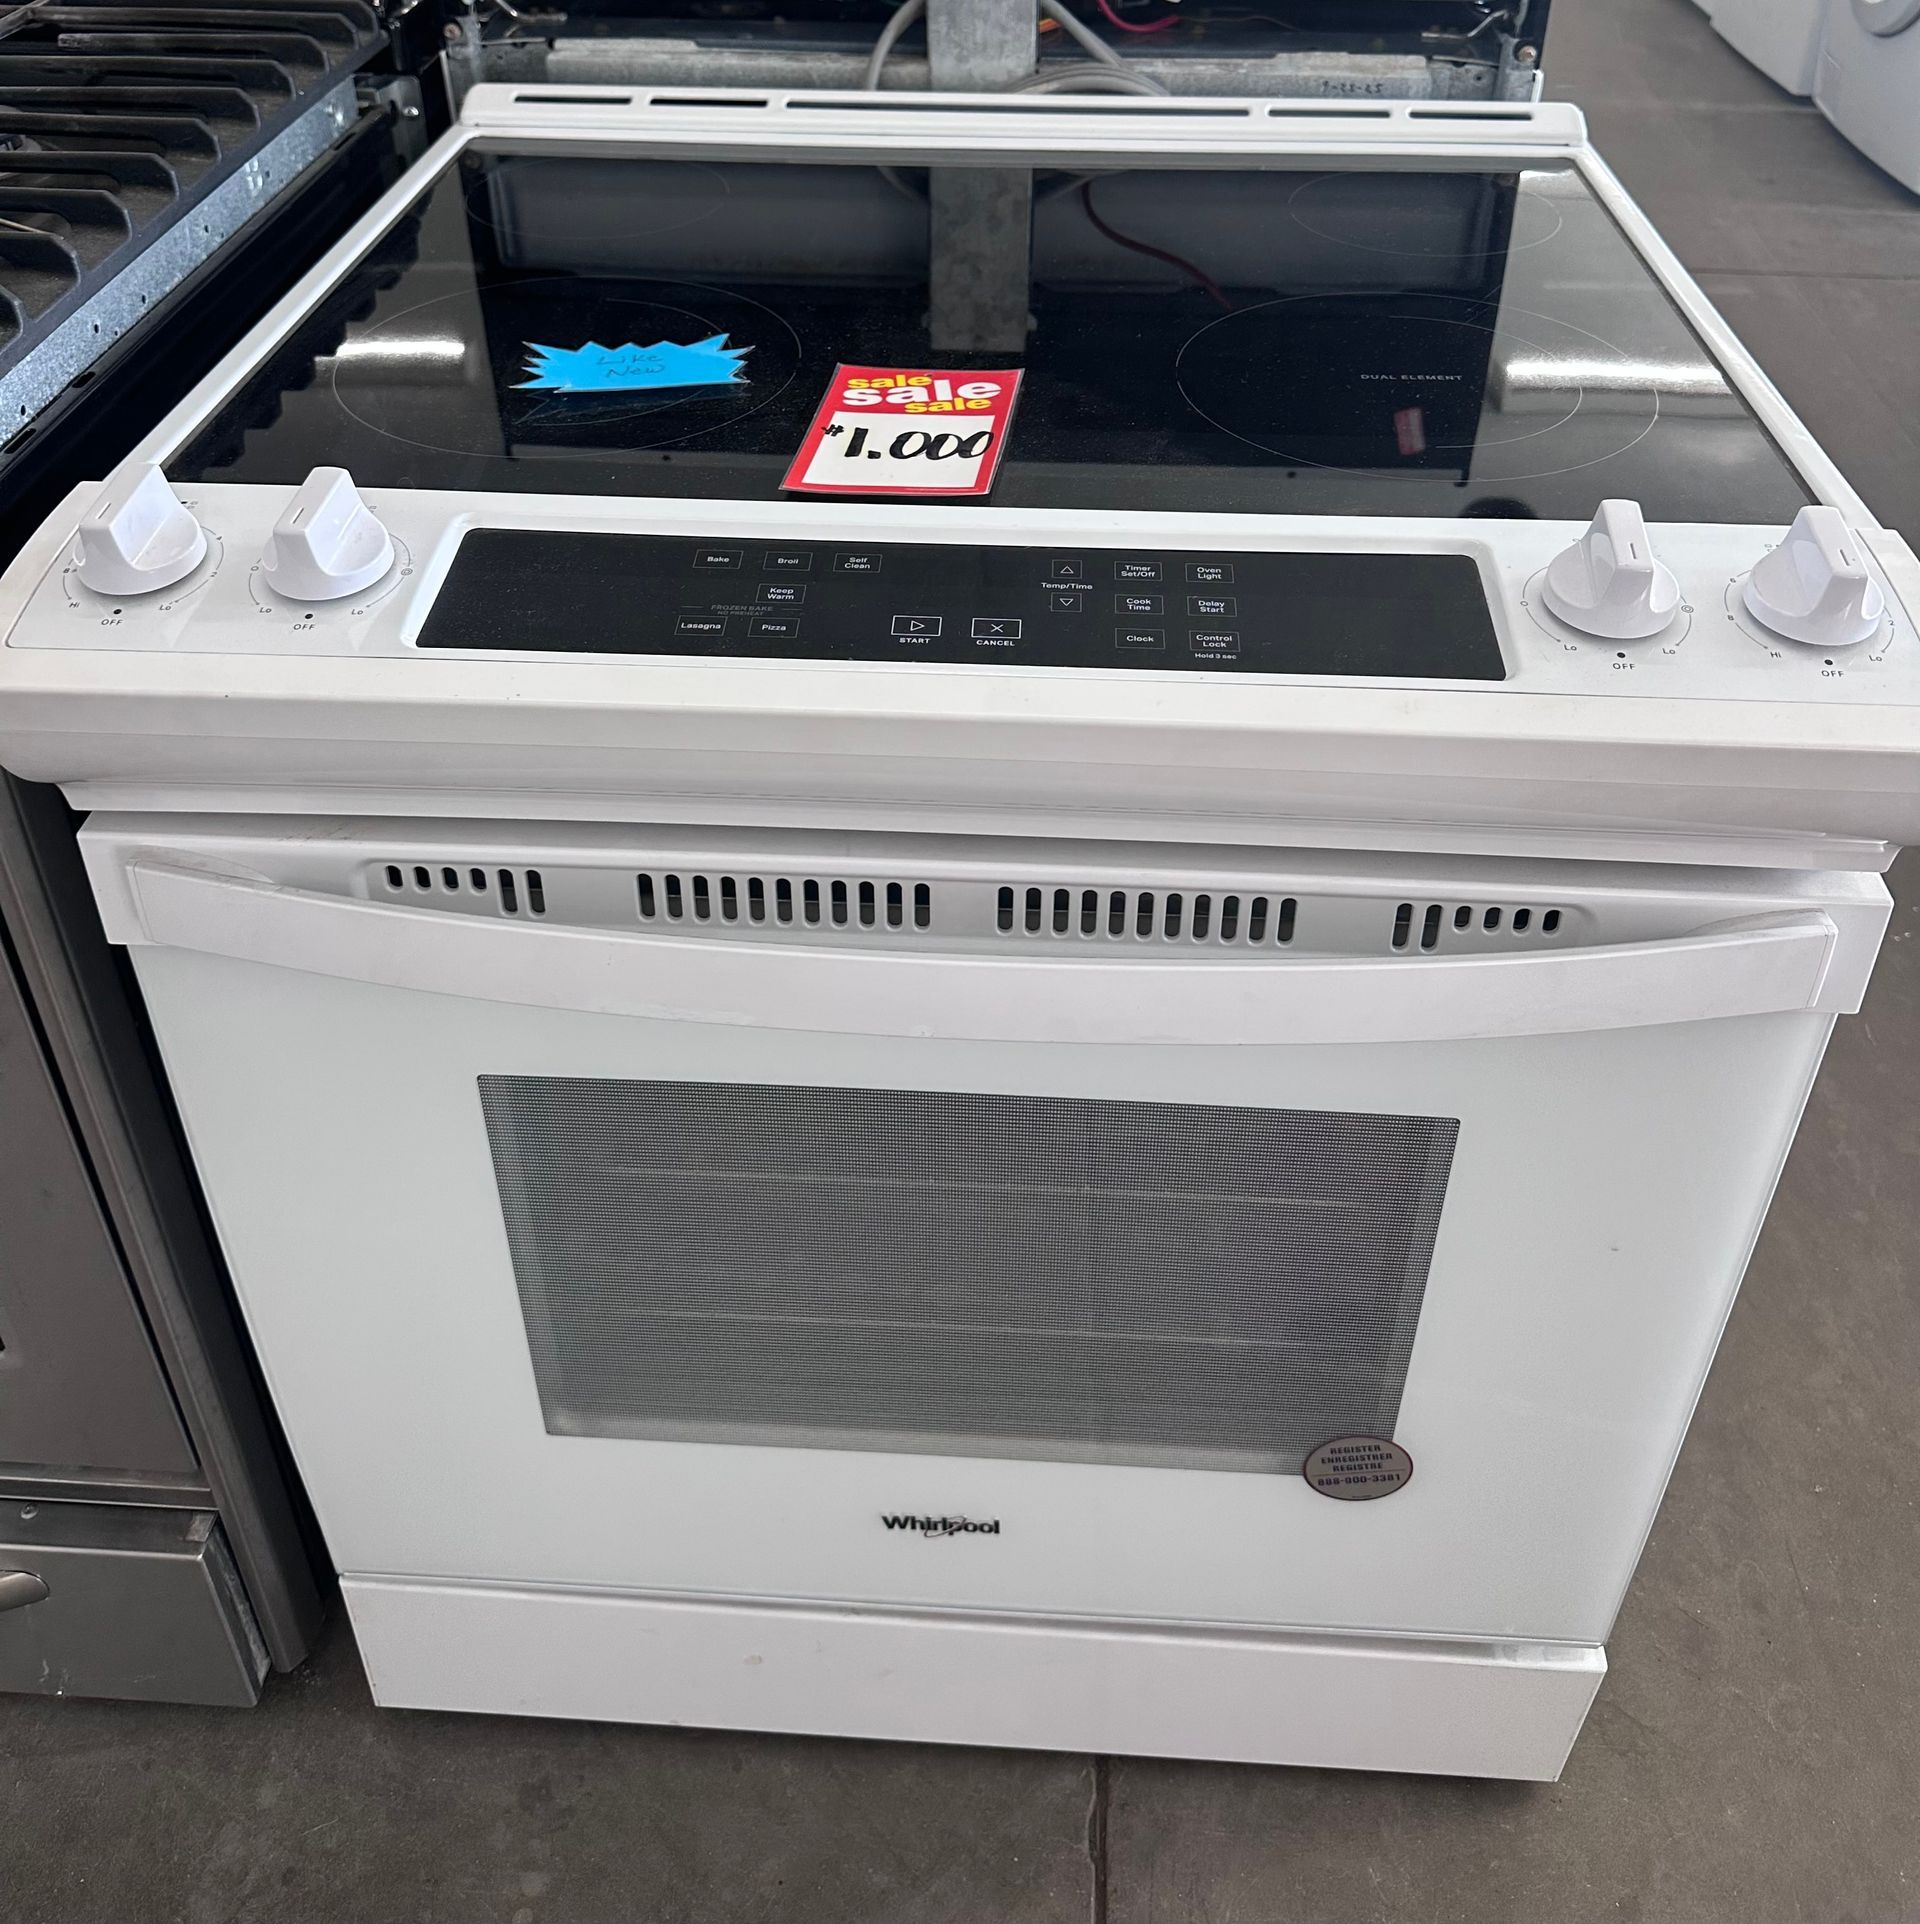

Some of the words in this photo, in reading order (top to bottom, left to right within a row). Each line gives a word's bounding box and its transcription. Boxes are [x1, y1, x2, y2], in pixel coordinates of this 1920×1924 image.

[606, 364, 664, 377] New
[848, 375, 932, 389] sale
[842, 379, 1001, 406] sale
[904, 397, 992, 413] sale
[1041, 582, 1093, 590] Temp/Time
[1198, 600, 1225, 608] Delay
[351, 608, 364, 616] Lo
[101, 618, 123, 626] OFF
[680, 622, 722, 631] Lasagna
[293, 623, 316, 631] OFF
[1612, 662, 1636, 670] OFF
[1821, 670, 1845, 678] OFF
[1330, 1445, 1381, 1455] REGISTER
[1321, 1453, 1393, 1464] ENREGISTRER
[1333, 1463, 1383, 1472] REGISTRE
[881, 1515, 1000, 1536] Whirlpool
